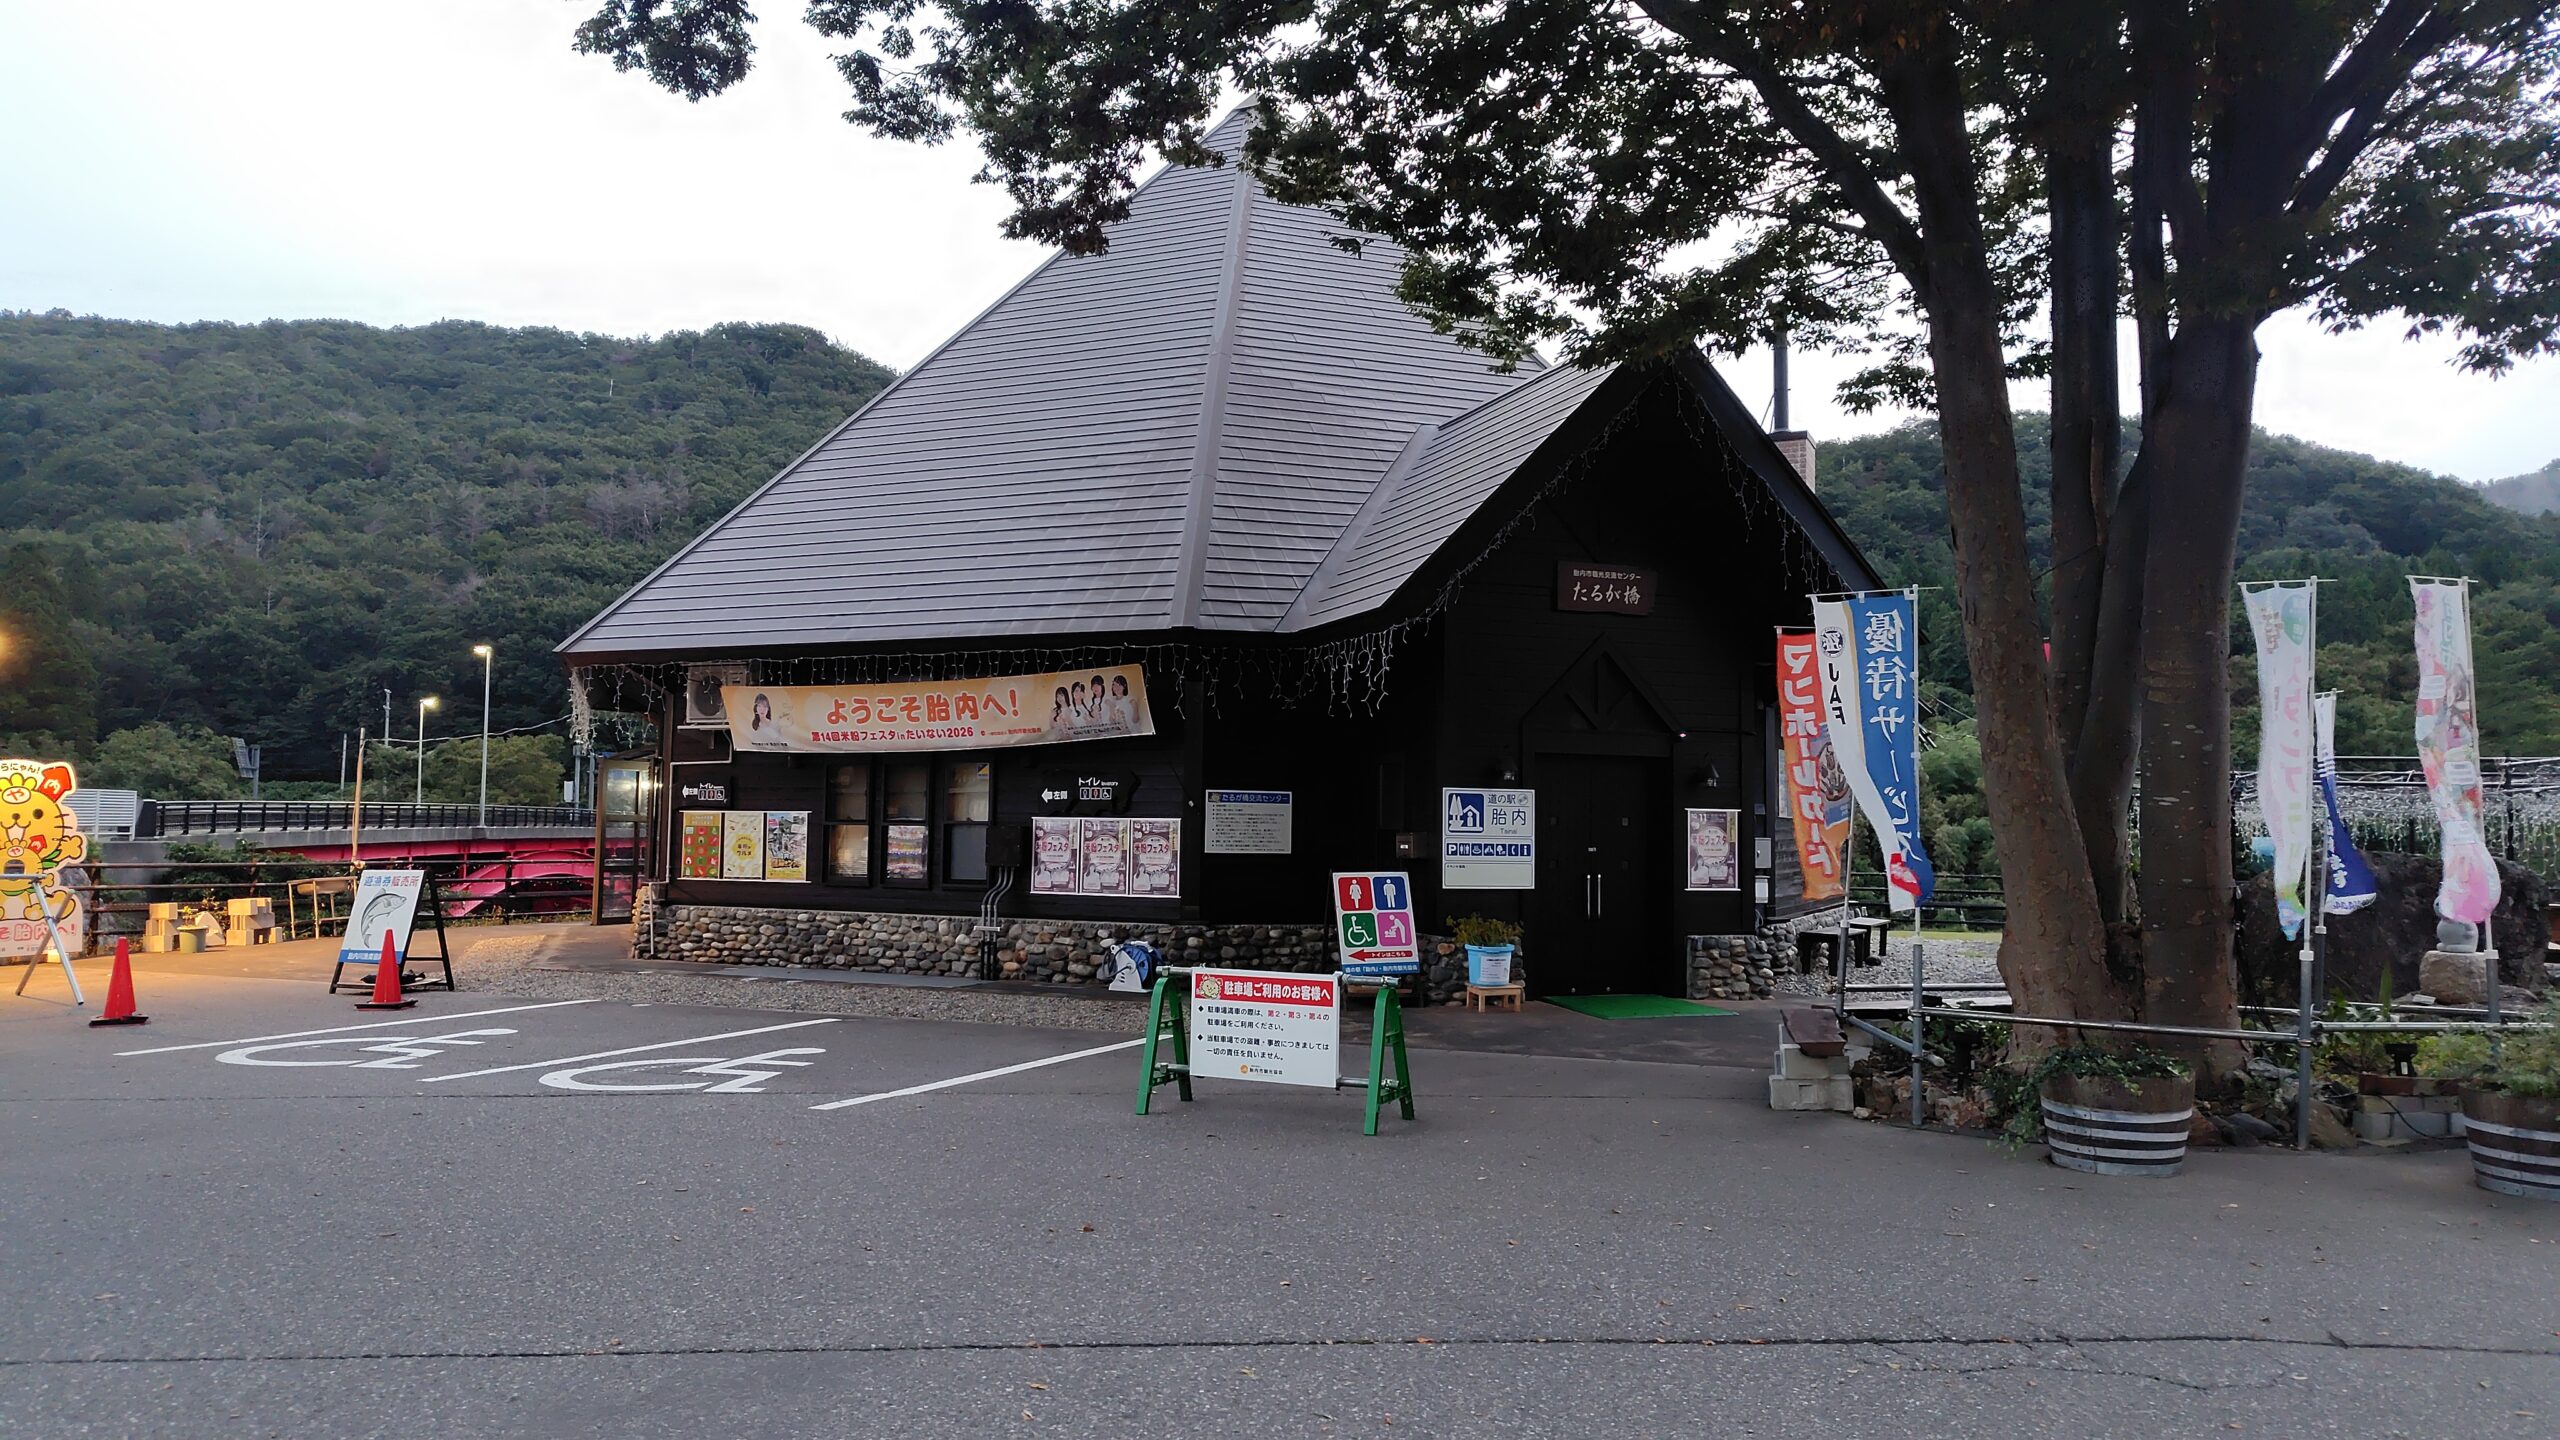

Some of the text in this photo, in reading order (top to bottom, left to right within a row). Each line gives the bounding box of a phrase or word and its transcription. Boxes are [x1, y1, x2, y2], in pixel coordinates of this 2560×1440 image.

[1573, 581, 1641, 605] たるが橋
[826, 689, 1020, 725] ようこそ胎内へ!
[1078, 777, 1100, 787] トイレ
[1053, 790, 1068, 800] 左側
[1487, 794, 1516, 804] 道の駅
[1491, 808, 1527, 826] 胎内
[364, 875, 420, 887] 遊漁券販売所
[1224, 980, 1331, 1001] 駐車場ご利用のお客様へ
[1207, 1018, 1284, 1031] 駐車場をご利用ください。
[1206, 1048, 1284, 1061] 一切の責任を負いません。
